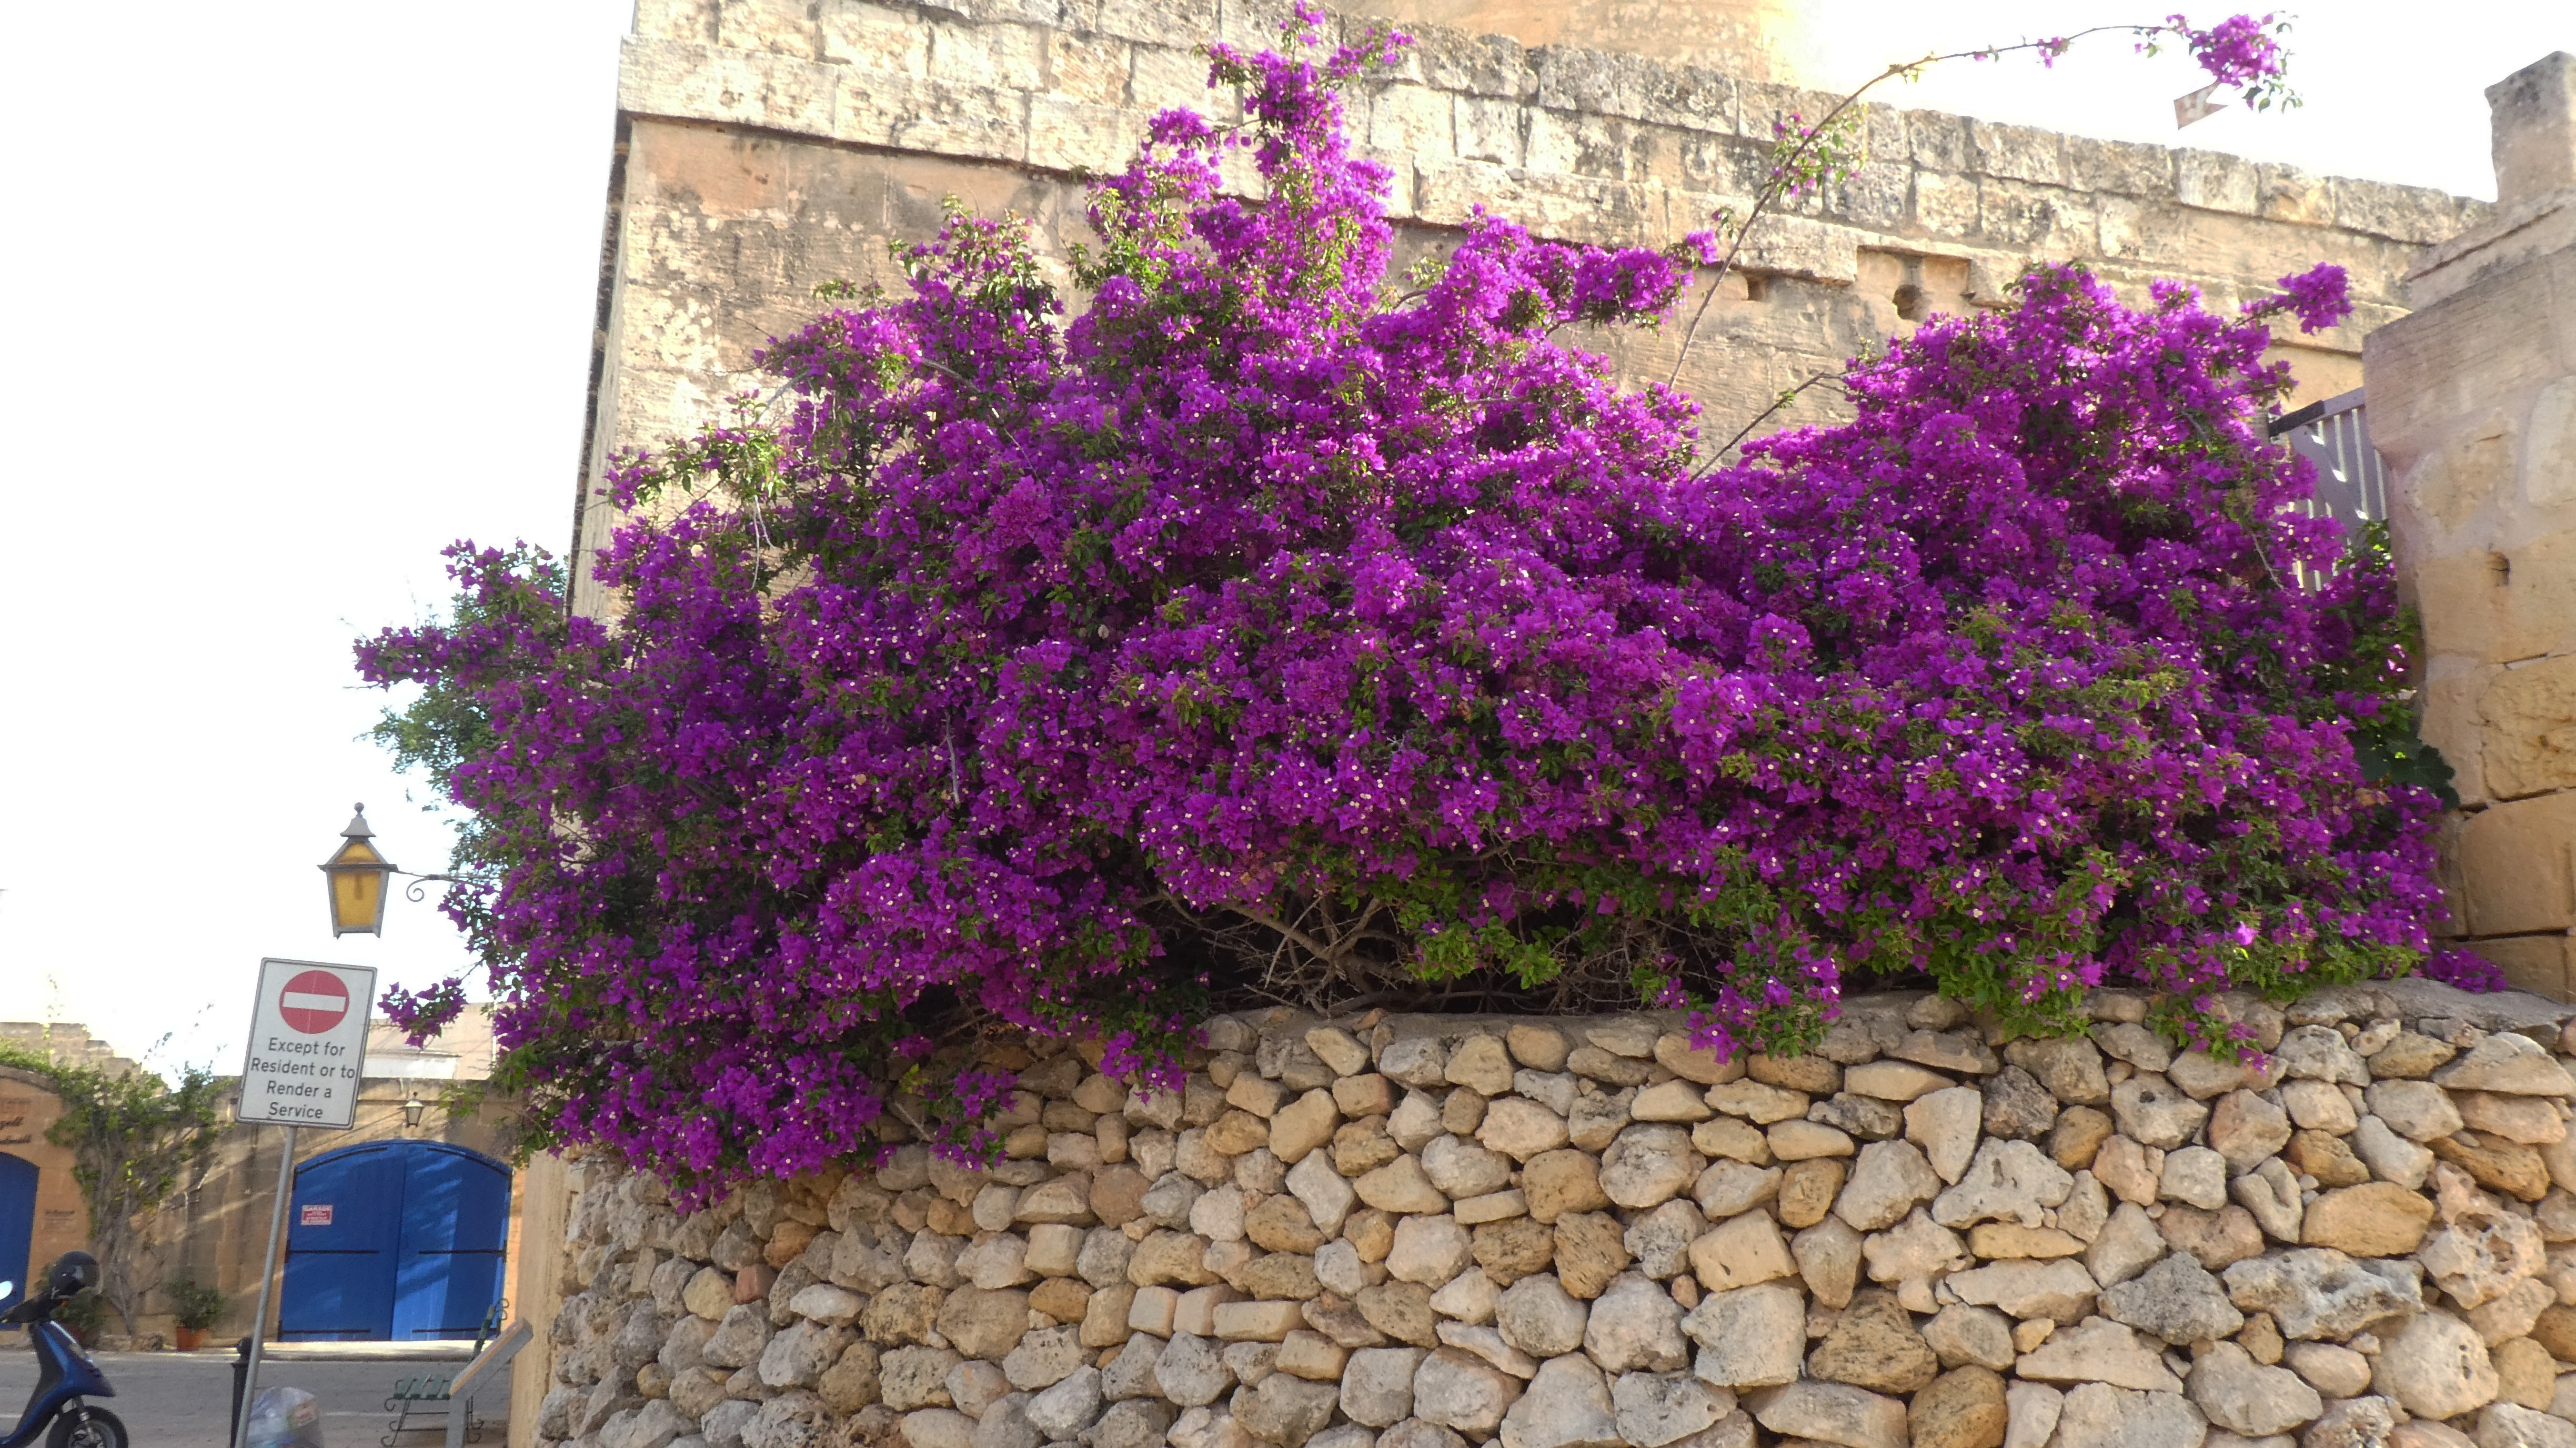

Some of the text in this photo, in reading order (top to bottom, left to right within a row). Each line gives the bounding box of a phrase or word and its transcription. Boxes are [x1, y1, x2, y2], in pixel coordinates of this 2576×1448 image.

[268, 1037, 345, 1056] Except for
[250, 1058, 355, 1079] Resident or to
[267, 1080, 331, 1098] Render a
[269, 1102, 323, 1119] Service
